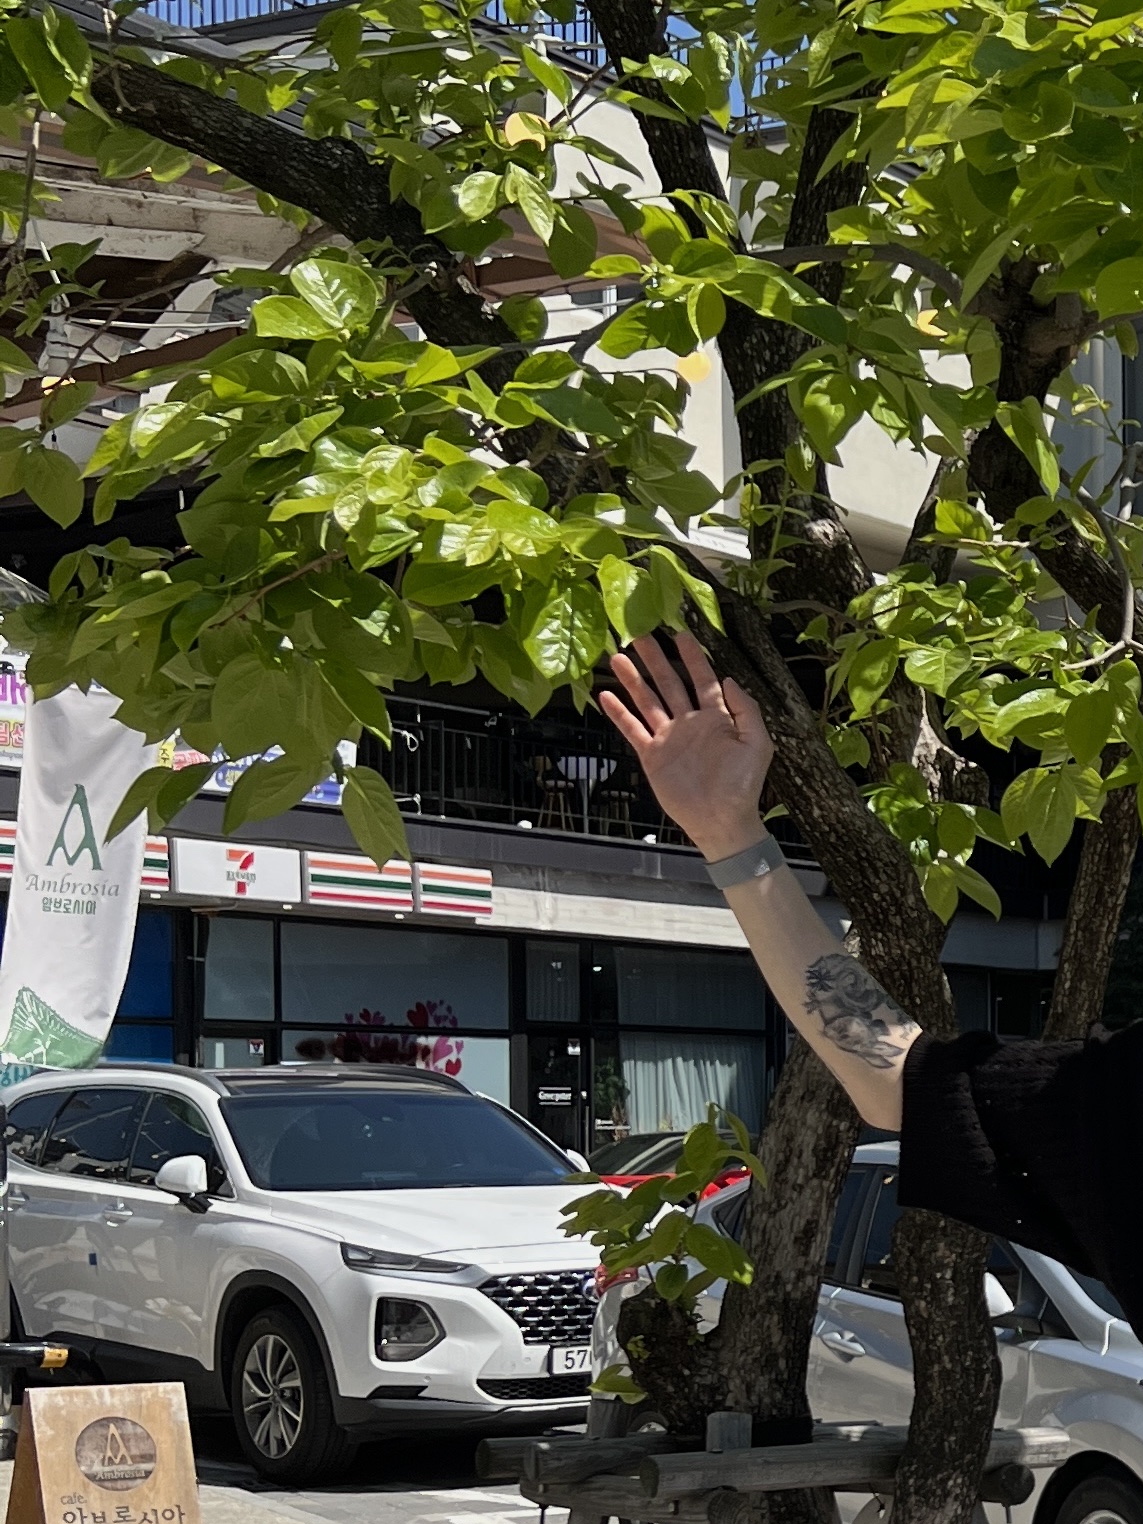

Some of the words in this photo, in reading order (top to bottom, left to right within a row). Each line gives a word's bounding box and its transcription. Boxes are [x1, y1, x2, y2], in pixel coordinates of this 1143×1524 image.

[25, 872, 120, 897] Ambrosia
[42, 896, 97, 915] 암브로시아
[564, 1349, 592, 1369] 57
[95, 1469, 147, 1480] Ambrosia
